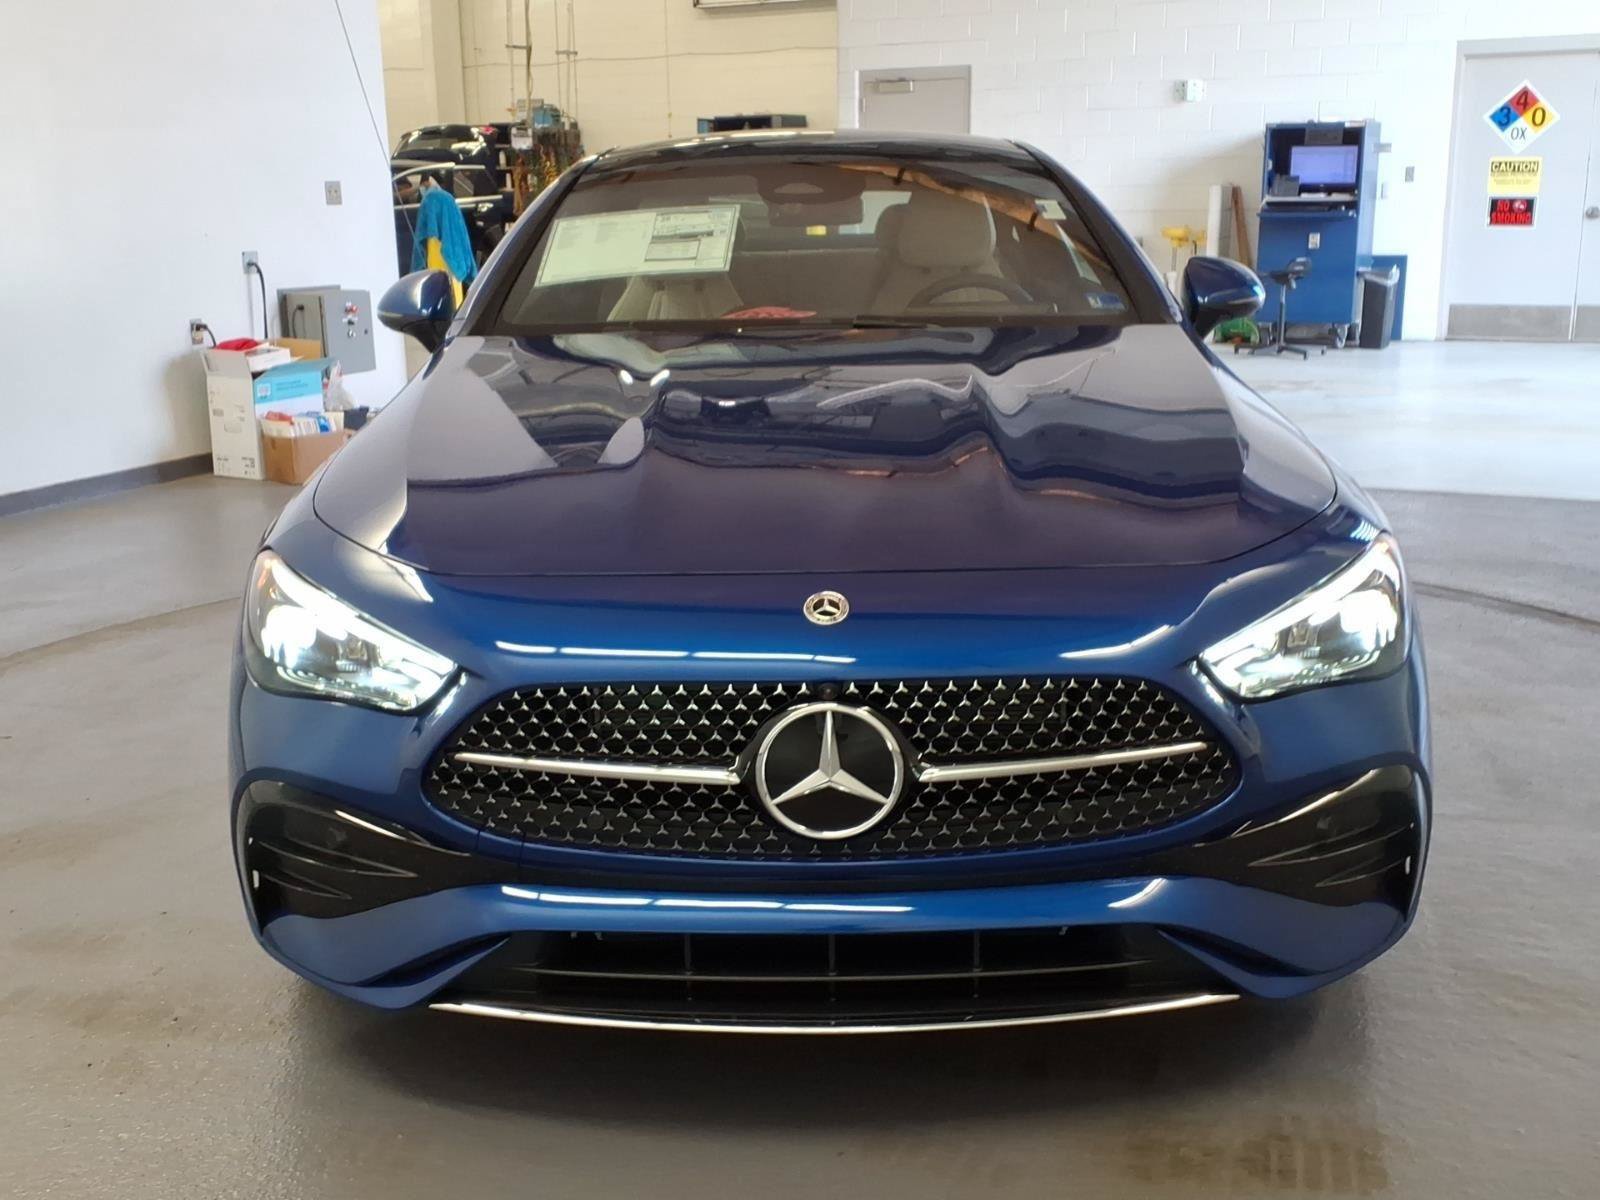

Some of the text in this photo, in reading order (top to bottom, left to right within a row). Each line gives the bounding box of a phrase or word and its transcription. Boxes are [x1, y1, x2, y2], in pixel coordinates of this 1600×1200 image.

[1516, 90, 1529, 109] 4
[1497, 106, 1511, 127] 3
[1510, 126, 1528, 141] OX
[1492, 161, 1538, 173] CAUTION
[1496, 200, 1510, 212] NO
[1491, 212, 1531, 225] SMOKING
